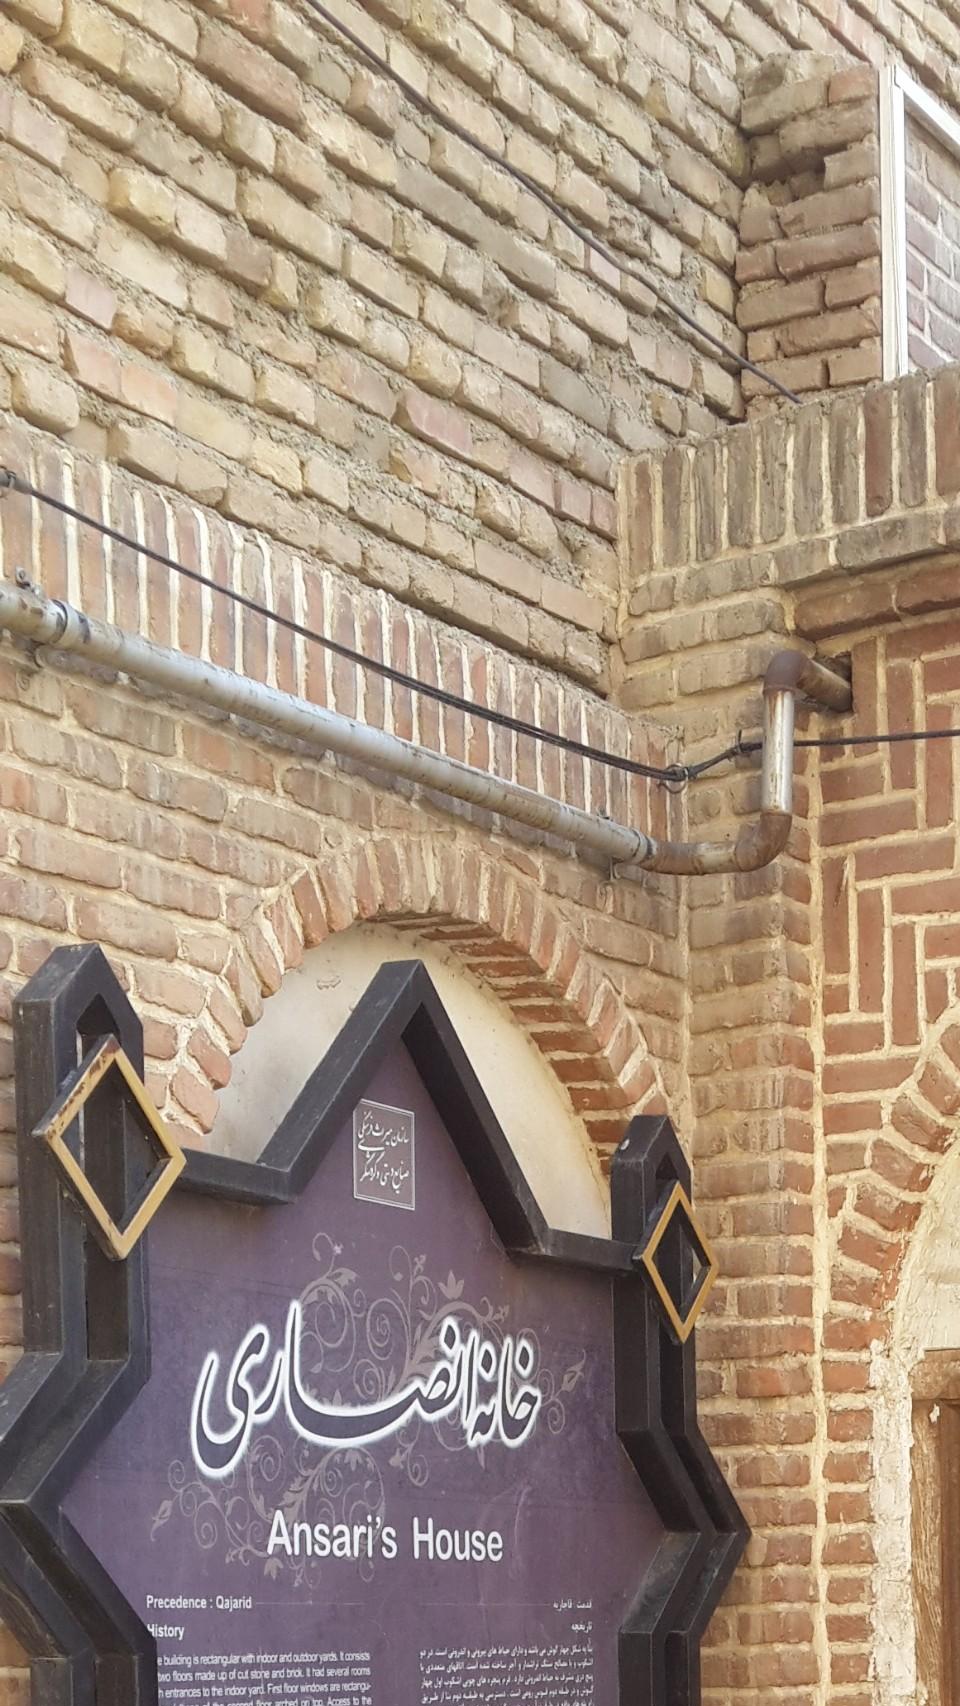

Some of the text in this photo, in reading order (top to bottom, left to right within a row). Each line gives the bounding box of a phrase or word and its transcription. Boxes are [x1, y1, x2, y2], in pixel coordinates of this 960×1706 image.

[190, 1299, 542, 1479] خانه انصاری
[266, 1508, 504, 1562] Ansari's House
[146, 1594, 207, 1609] Precedence
[216, 1595, 252, 1612] Qajarid
[147, 1623, 185, 1640] History
[164, 1654, 192, 1668] building
[200, 1654, 240, 1666] rectangular
[241, 1652, 256, 1664] with
[256, 1652, 278, 1663] indoor
[280, 1652, 292, 1662] and
[293, 1652, 318, 1662] outdoor
[345, 1652, 370, 1660] consists
[173, 1670, 193, 1681] floors
[195, 1670, 215, 1680] made
[218, 1672, 227, 1682] up
[237, 1670, 248, 1679] cut
[250, 1670, 270, 1679] stone
[272, 1668, 284, 1678] and
[312, 1666, 324, 1677] had
[326, 1666, 349, 1676] several
[351, 1667, 371, 1676] rooms
[165, 1688, 201, 1698] entrances
[211, 1686, 224, 1696] the
[224, 1685, 247, 1696] indoor
[267, 1683, 282, 1694] First
[284, 1683, 299, 1693] floor
[300, 1682, 328, 1692] windows
[330, 1683, 340, 1692] are
[327, 1697, 350, 1706] Access
[361, 1696, 372, 1705] the
